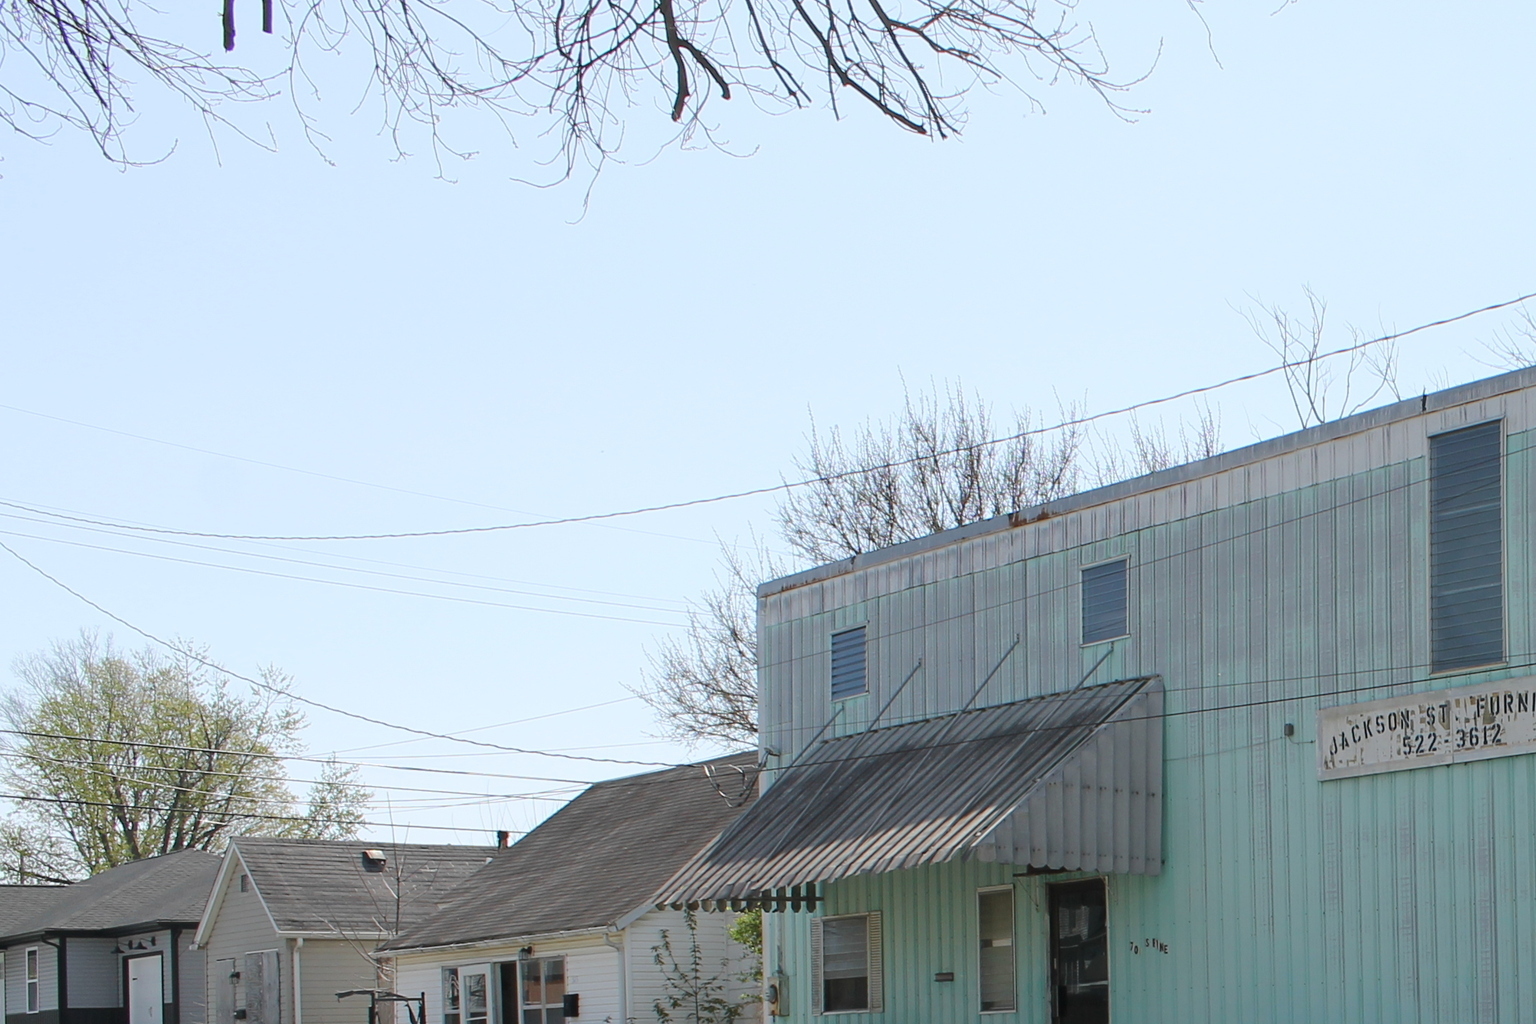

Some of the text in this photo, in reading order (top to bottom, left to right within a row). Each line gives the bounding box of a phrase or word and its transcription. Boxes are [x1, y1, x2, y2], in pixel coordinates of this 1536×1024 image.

[1329, 709, 1410, 756] JACKSON
[1426, 704, 1448, 726] ST
[1402, 723, 1502, 756] 522-3612
